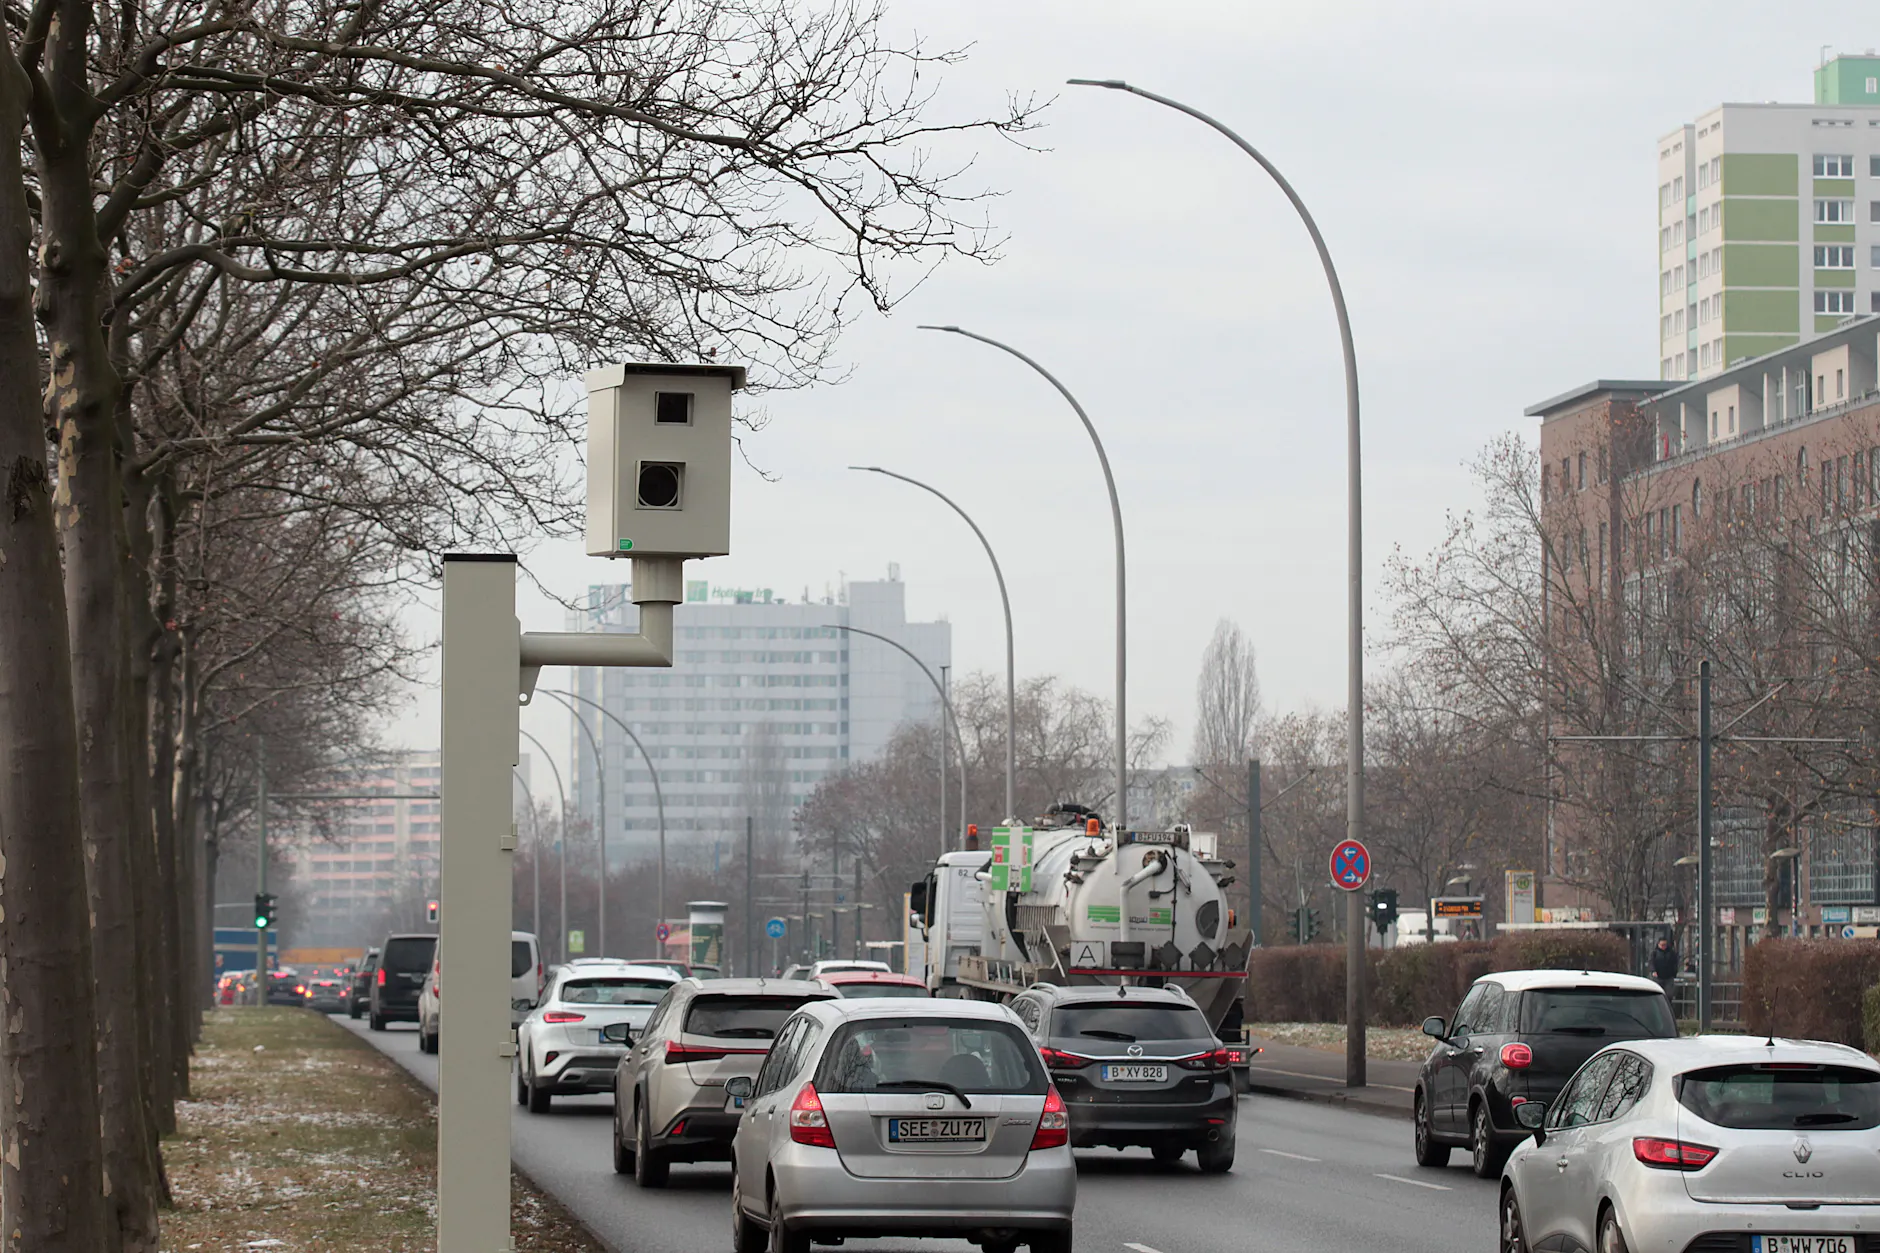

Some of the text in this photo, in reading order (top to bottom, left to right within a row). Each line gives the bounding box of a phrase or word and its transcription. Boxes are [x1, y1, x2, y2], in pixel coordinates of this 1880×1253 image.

[1078, 945, 1096, 963] A
[1112, 1067, 1162, 1078] B XY 828
[900, 1121, 982, 1136] SEE ZU 77
[1768, 1238, 1847, 1253] B WW 706
